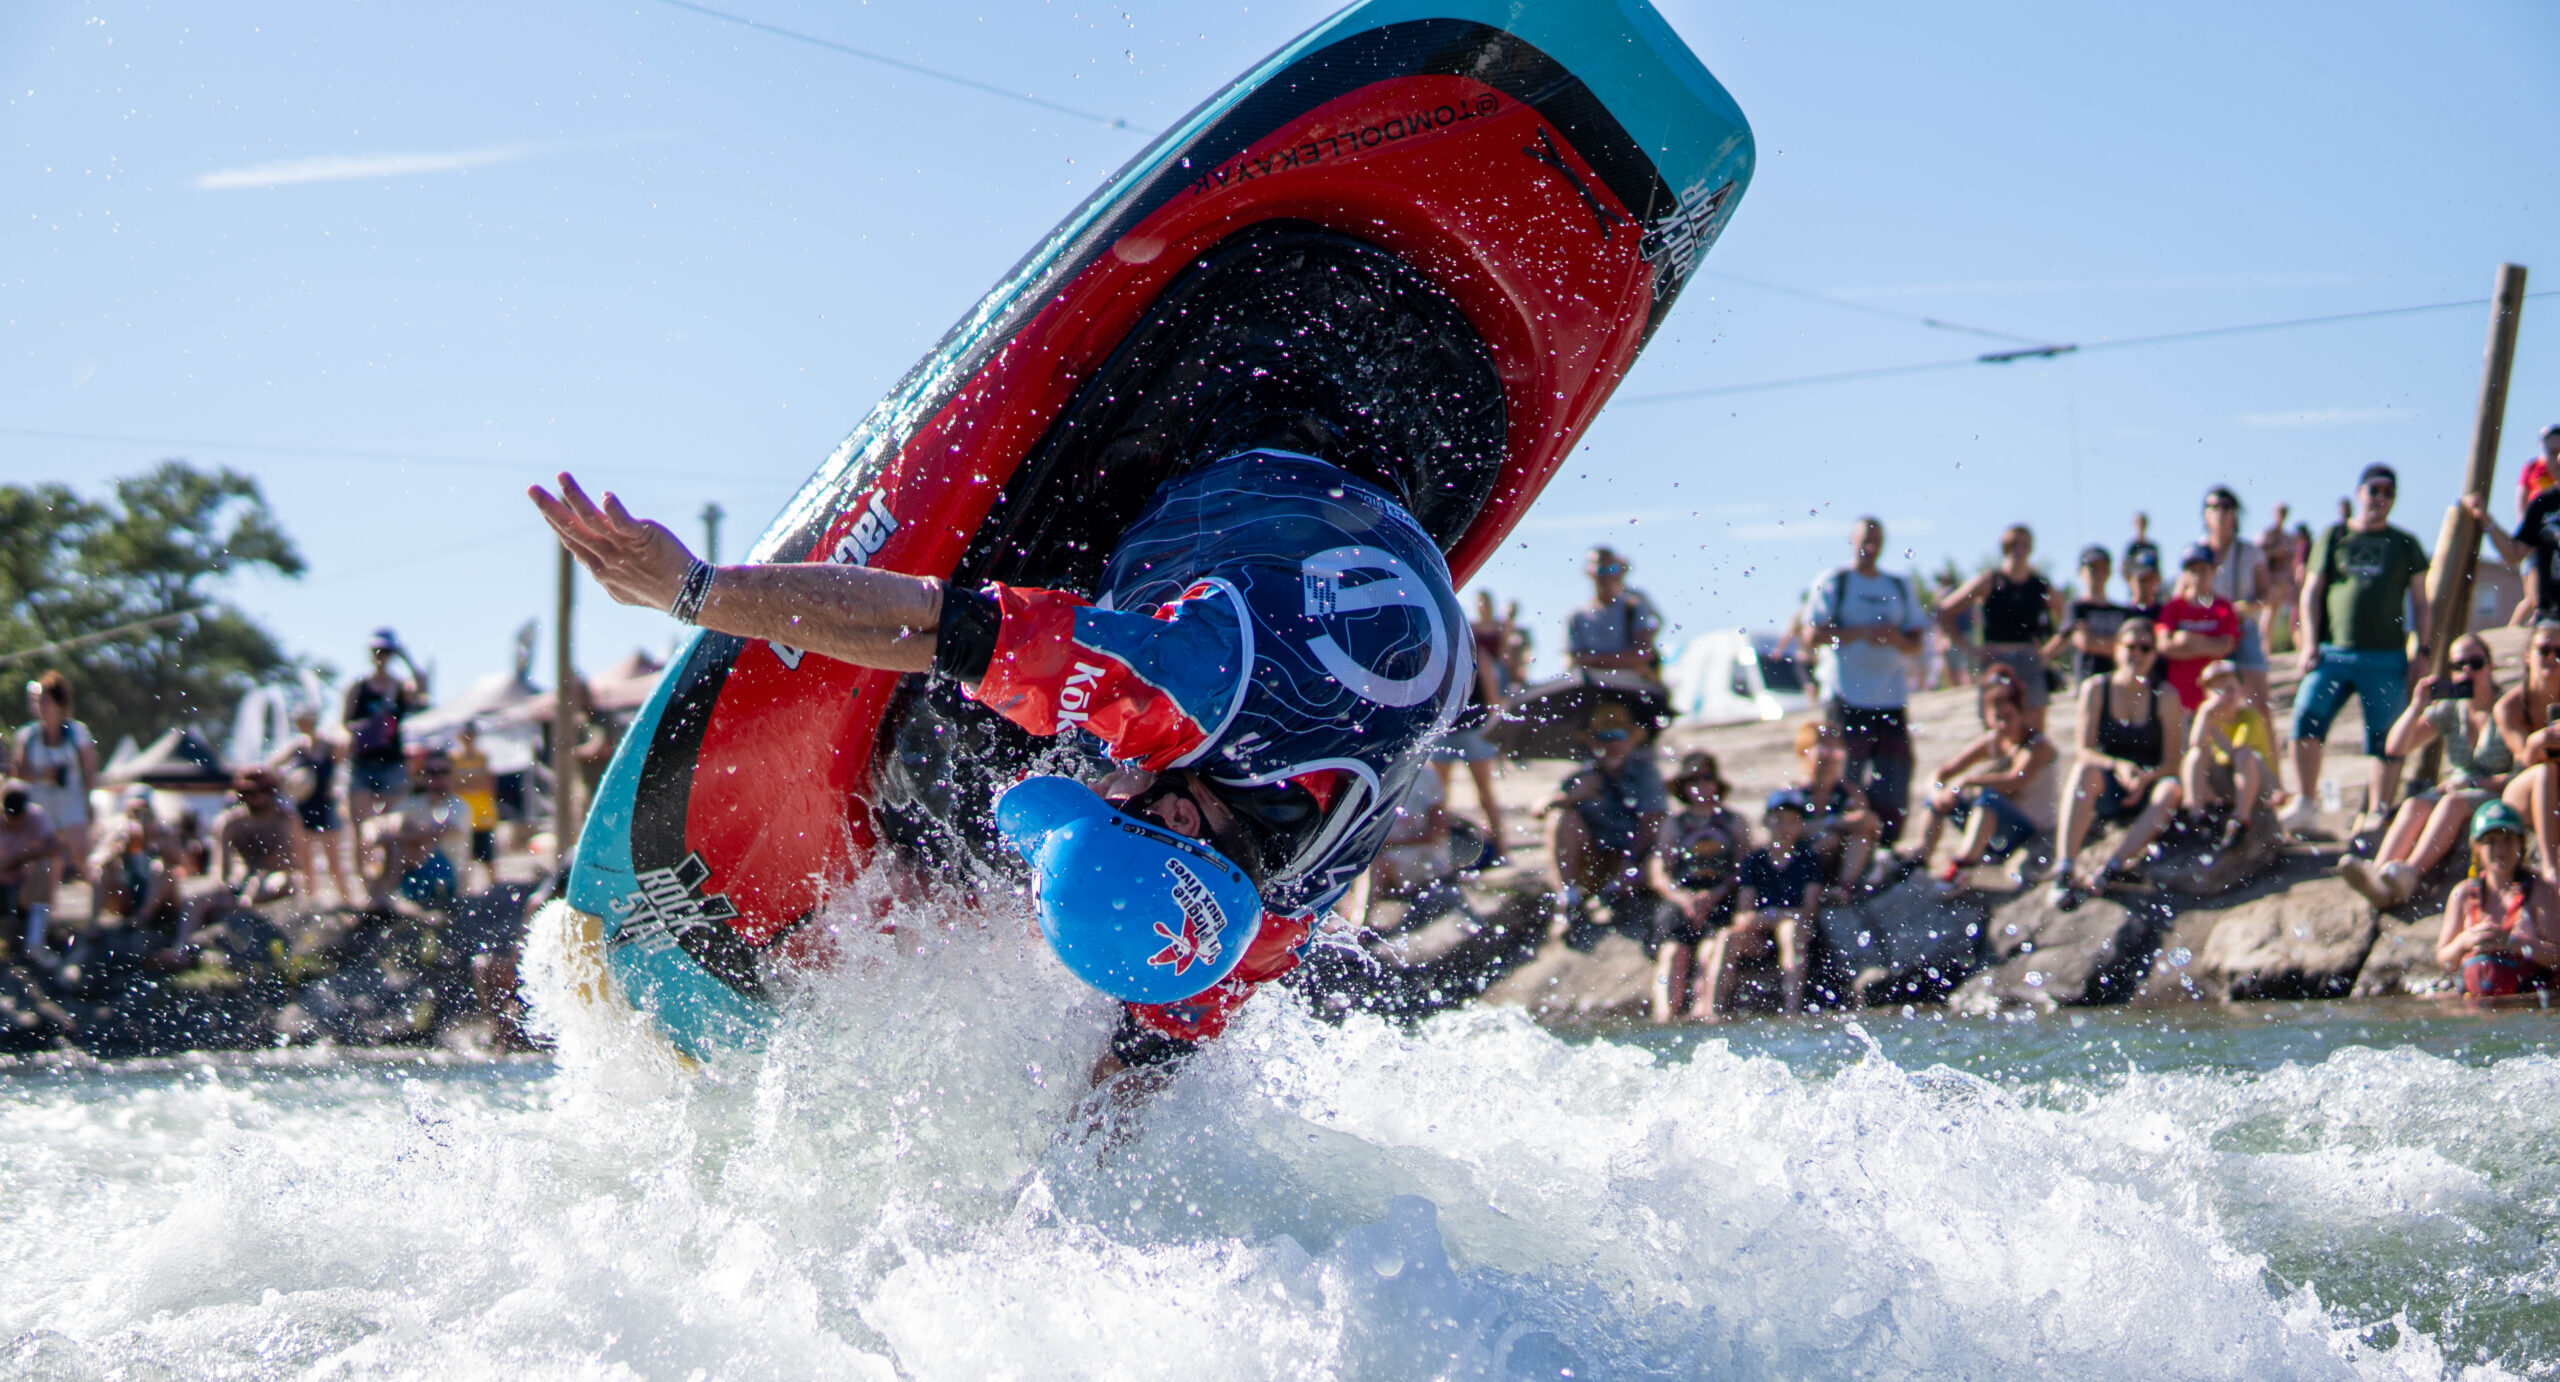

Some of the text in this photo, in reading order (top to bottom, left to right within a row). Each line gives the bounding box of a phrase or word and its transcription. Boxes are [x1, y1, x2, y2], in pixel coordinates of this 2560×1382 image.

[1193, 92, 1499, 196] @TOMDOLLEKAYAK
[636, 867, 711, 937] ROCK
[1167, 859, 1203, 898] Vives
[609, 890, 679, 953] STAR
[1173, 887, 1213, 944] Plagne
[1201, 893, 1226, 932] Eaux
